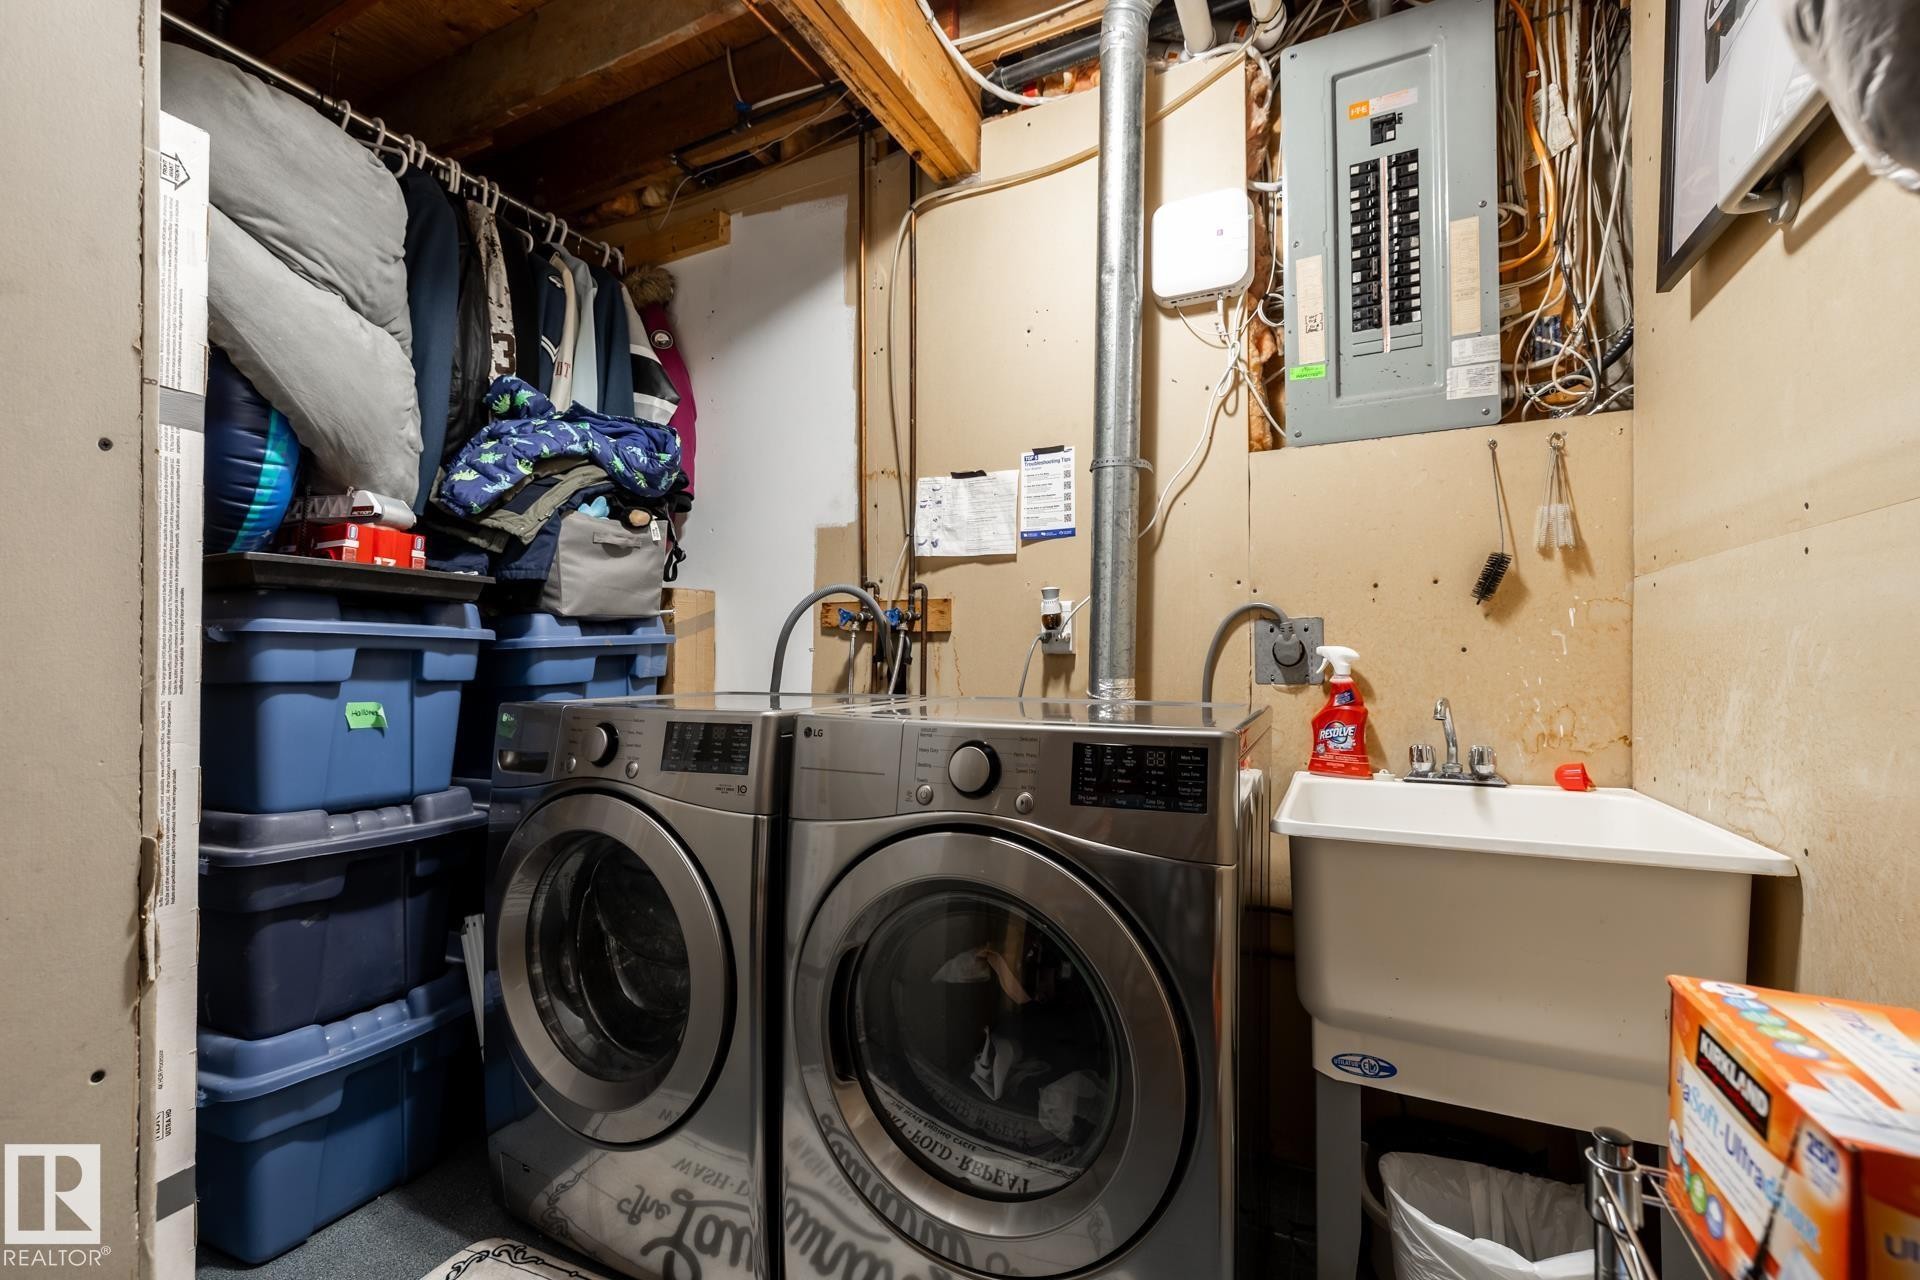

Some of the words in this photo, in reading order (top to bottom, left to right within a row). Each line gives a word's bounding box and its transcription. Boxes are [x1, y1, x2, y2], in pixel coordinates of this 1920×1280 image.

[1024, 459, 1060, 467] Troubleshooting
[813, 729, 823, 738] LG
[1319, 725, 1356, 740] RESOLVE
[1700, 1030, 1769, 1118] KIRKLAND
[165, 1109, 172, 1118] HD
